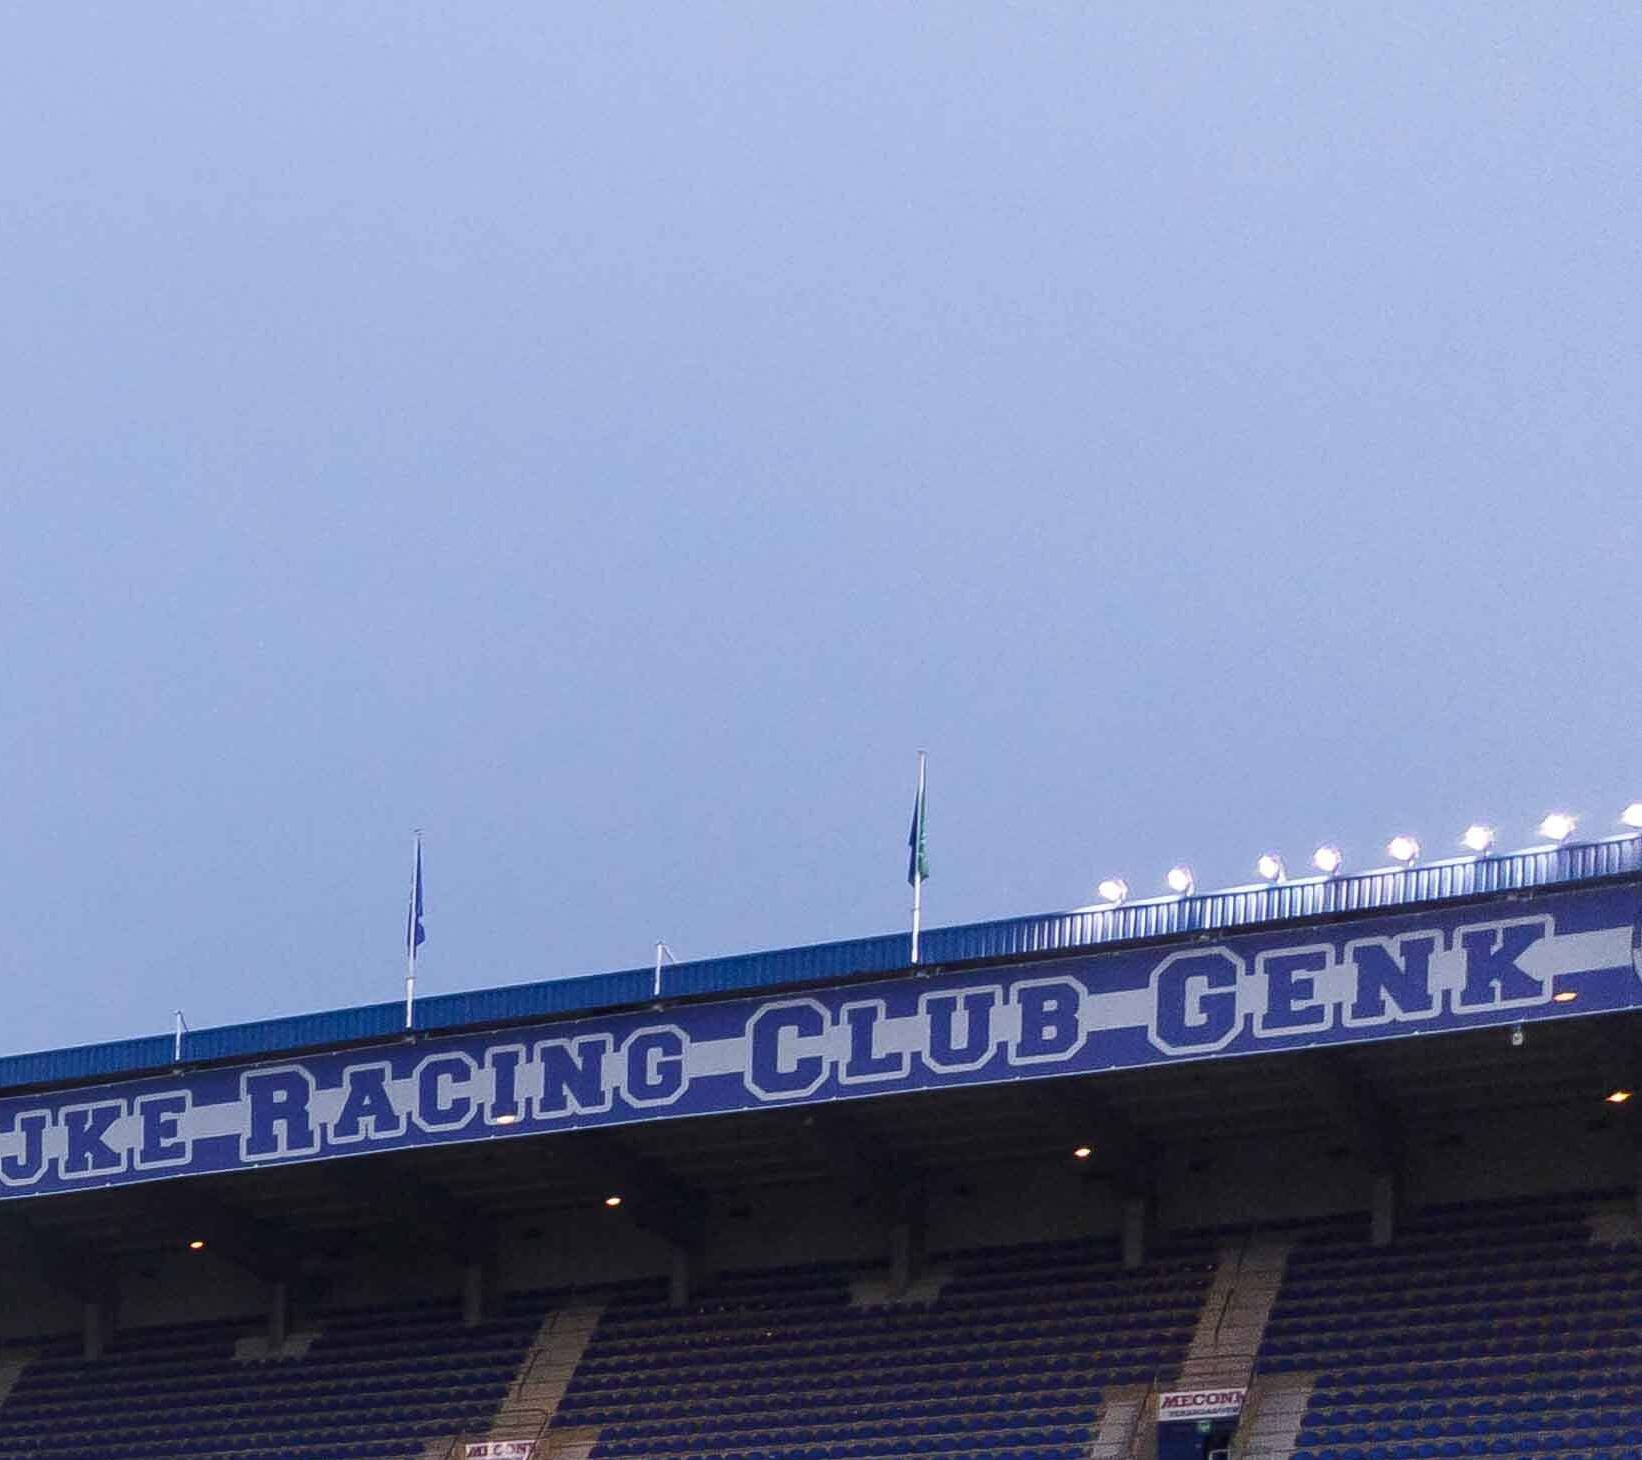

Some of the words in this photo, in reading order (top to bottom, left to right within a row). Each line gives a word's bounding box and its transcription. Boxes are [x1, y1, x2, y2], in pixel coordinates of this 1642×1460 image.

[240, 1024, 689, 1161] RACING
[744, 976, 1088, 1100] CLUB
[1148, 913, 1555, 1055] GENK
